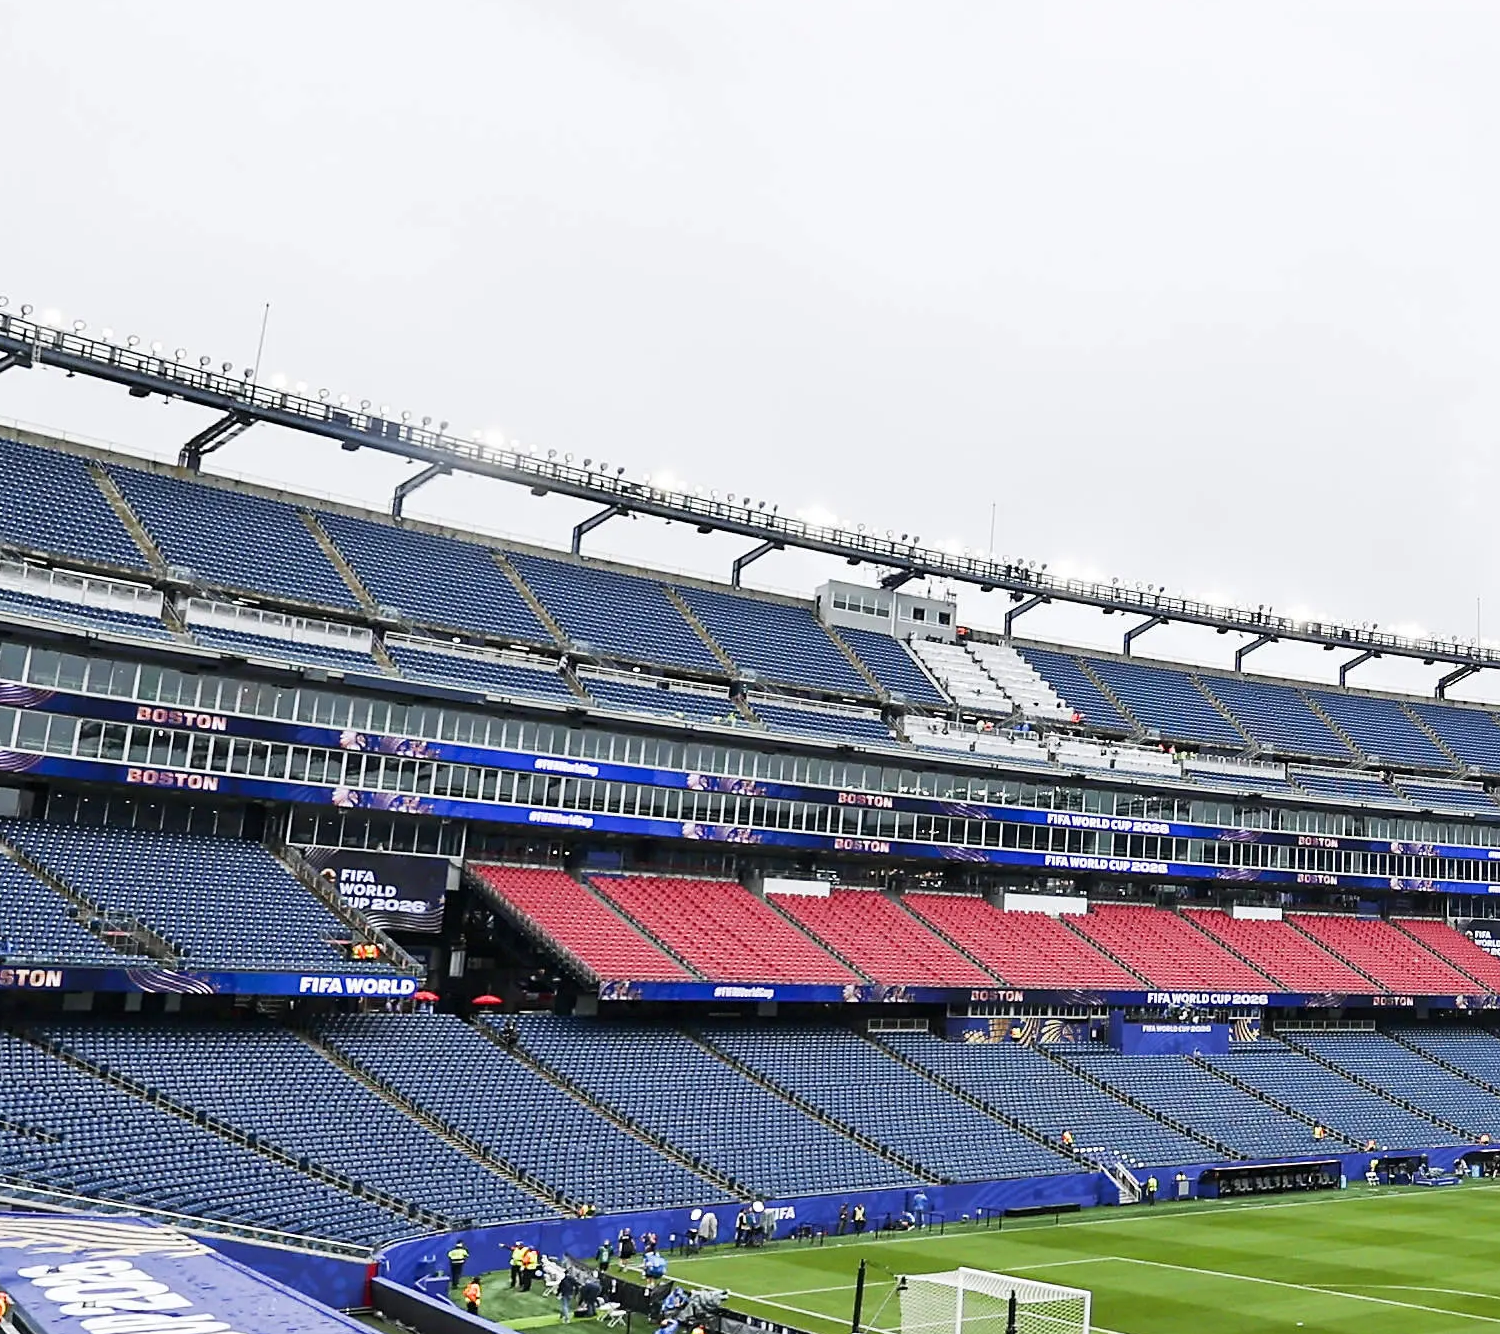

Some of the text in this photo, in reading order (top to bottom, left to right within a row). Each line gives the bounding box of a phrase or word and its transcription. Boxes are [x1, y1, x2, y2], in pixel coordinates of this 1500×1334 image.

[136, 708, 227, 731] BOSTON
[127, 768, 219, 791] BOSTON
[837, 793, 892, 808] BOSTON
[1047, 813, 1170, 834] FIFA WORLD CUP 2026
[835, 839, 889, 853] BOSTON
[1045, 856, 1169, 874] FIFA WORLD CUP 2026
[341, 869, 375, 882] FIFA
[340, 883, 396, 897] WORLD
[370, 900, 427, 912] 2026
[1474, 930, 1491, 939] FIFA
[300, 977, 415, 995] FIFA WORLD
[971, 990, 1024, 1002] BOSTON
[1147, 992, 1268, 1005] FIFA WORLD CUP 2026
[17, 1259, 194, 1316] 2026
